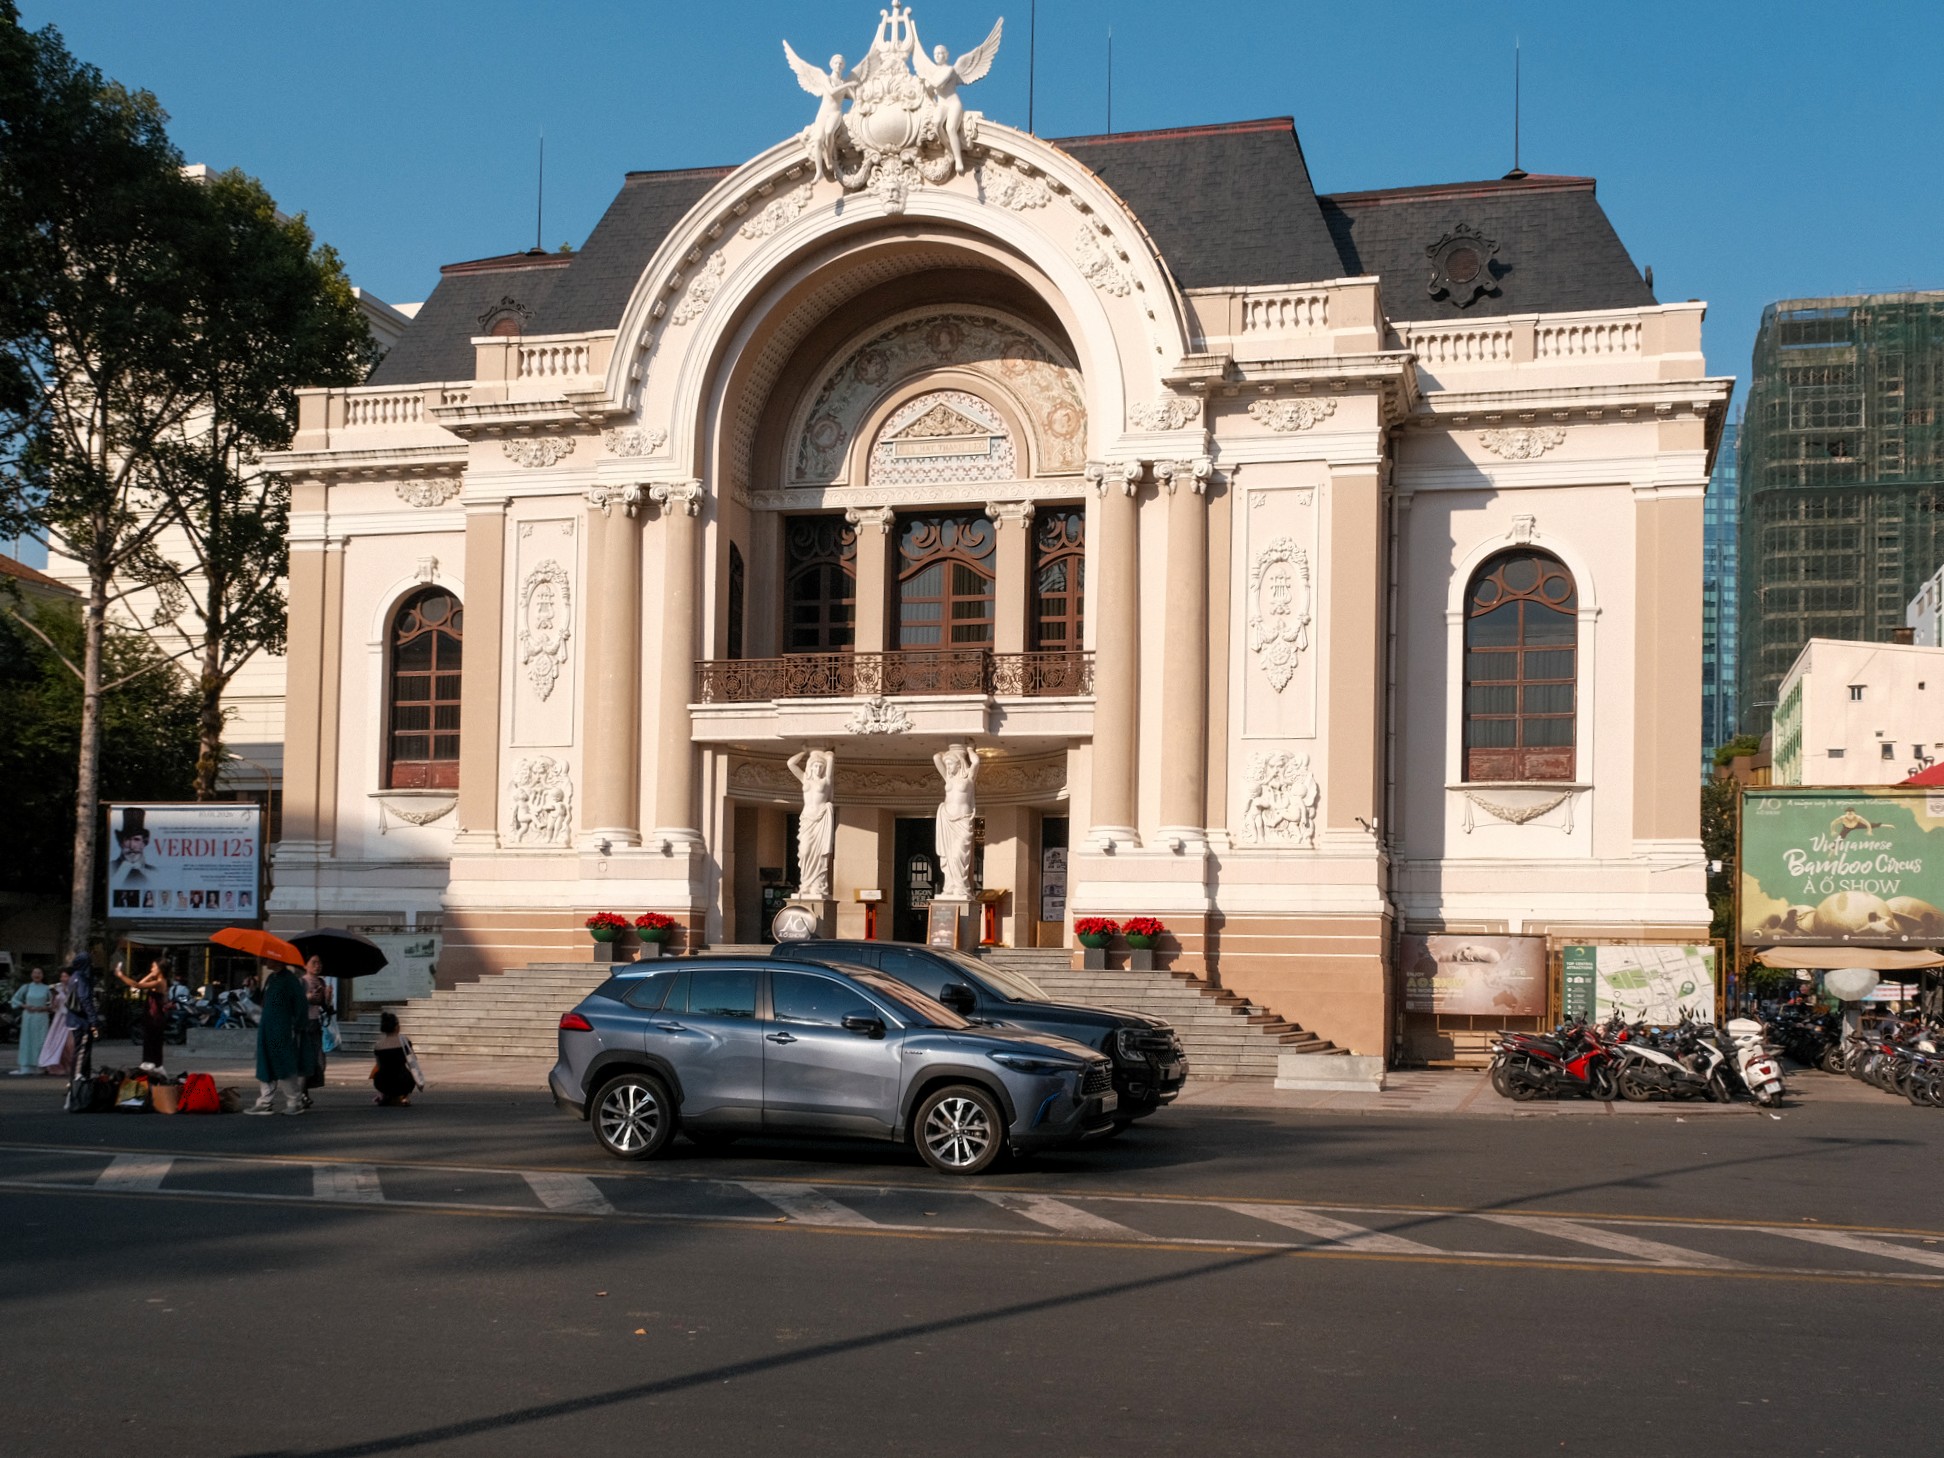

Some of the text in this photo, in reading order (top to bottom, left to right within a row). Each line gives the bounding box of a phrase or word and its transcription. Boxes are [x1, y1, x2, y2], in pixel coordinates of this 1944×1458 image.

[154, 838, 253, 857] VERDI 125
[1809, 832, 1893, 854] Vietnamese
[1783, 848, 1922, 877] Bamboo Circus
[1803, 875, 1817, 894] À
[1839, 879, 1901, 894] SHOW
